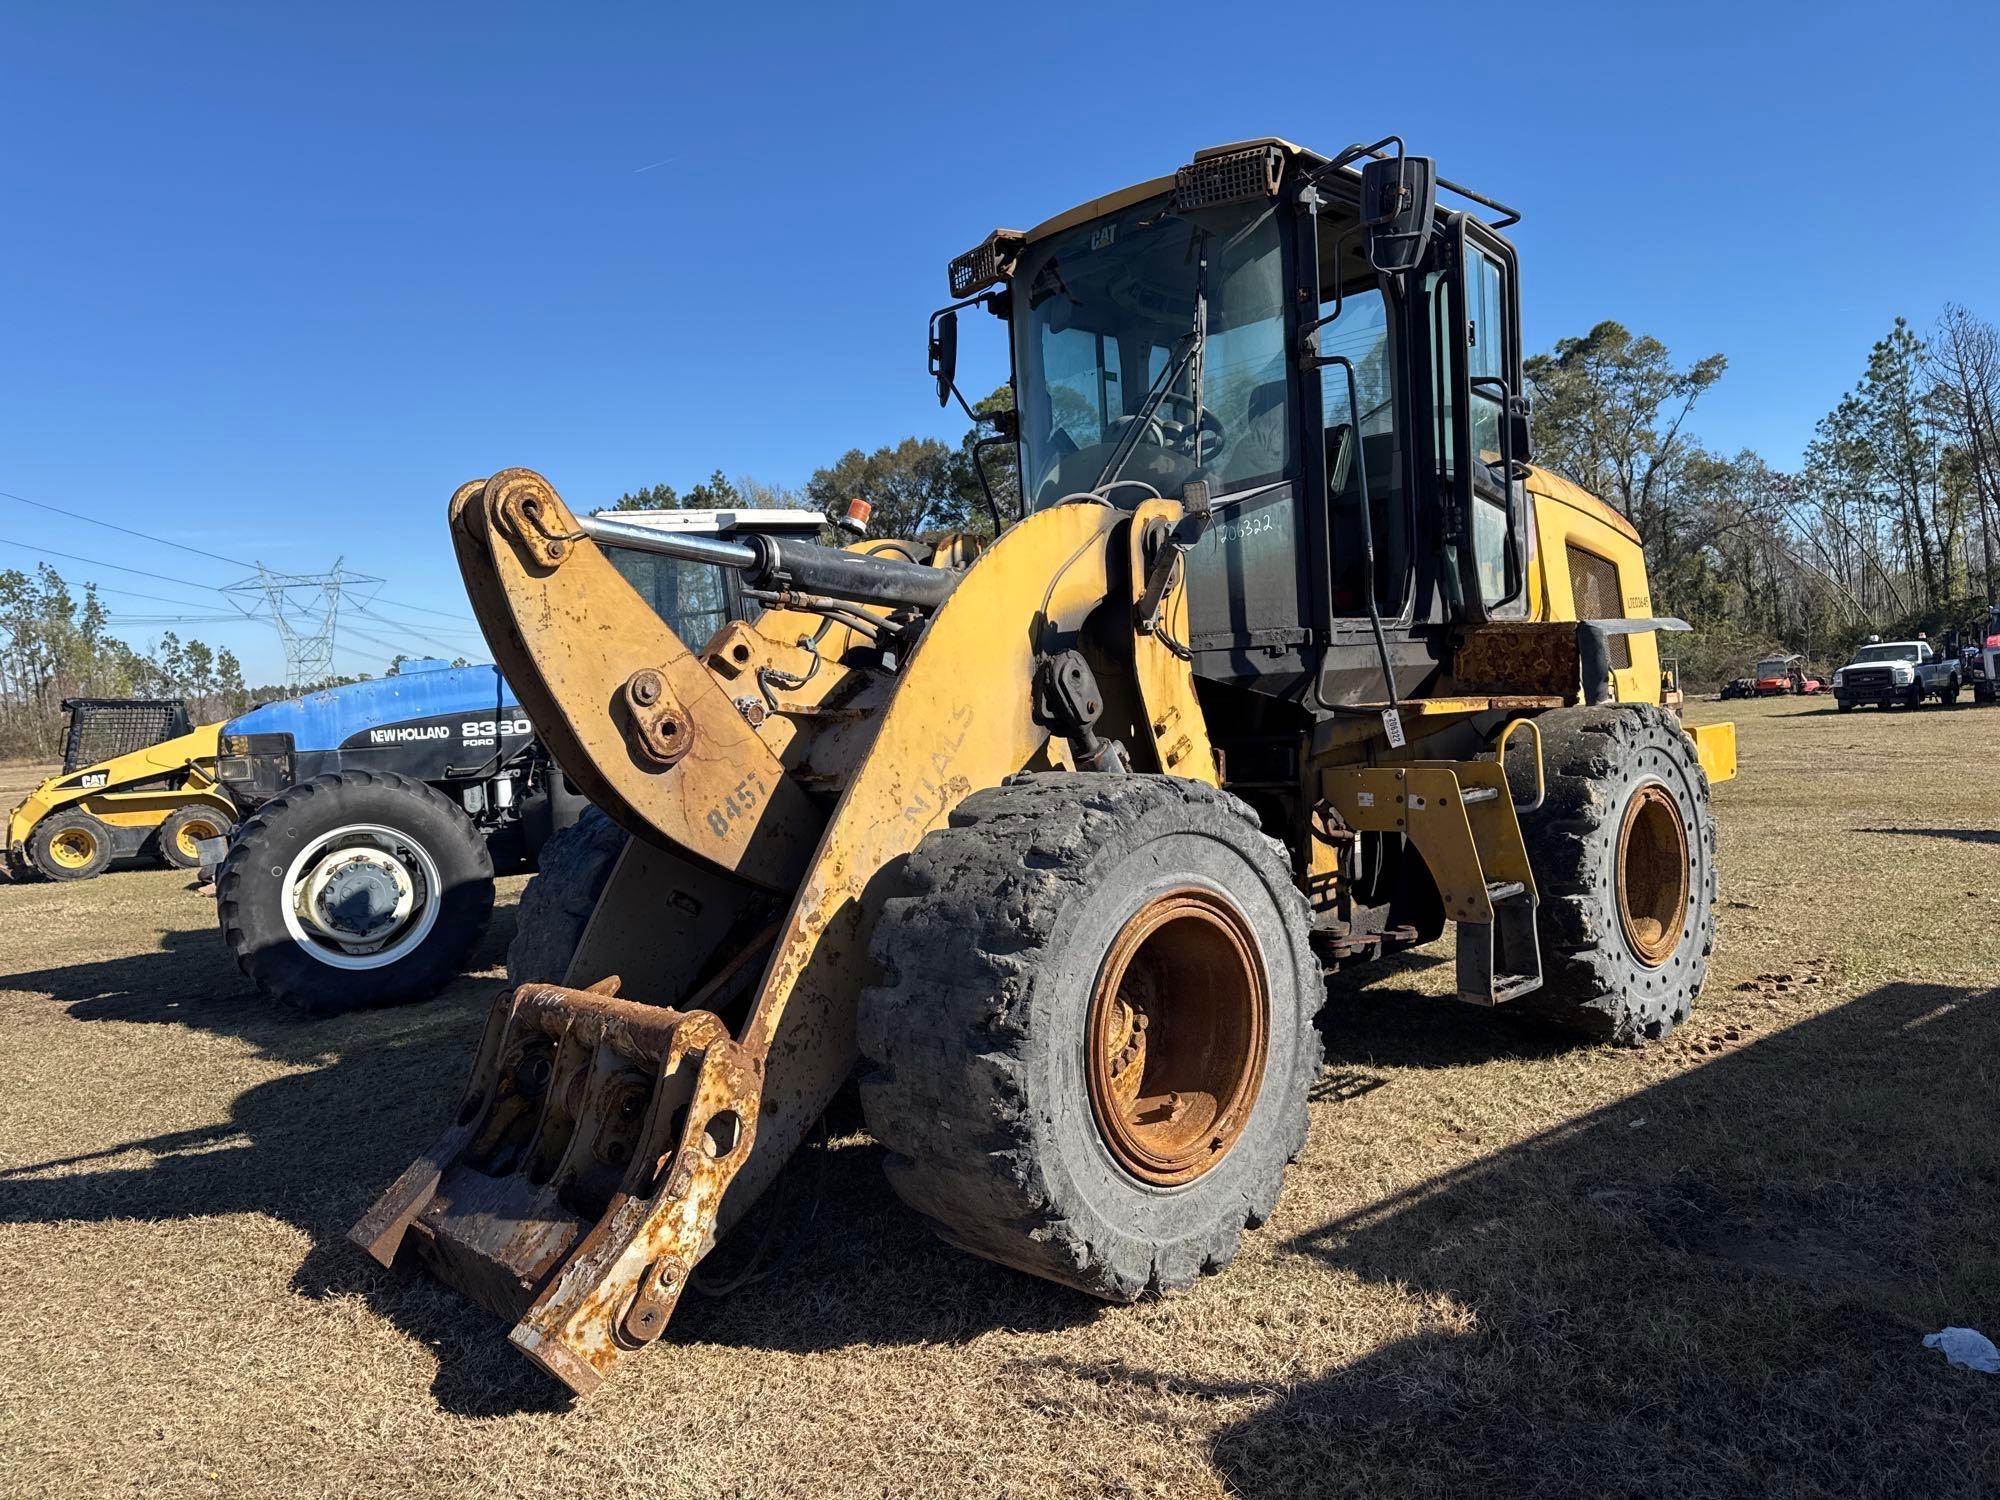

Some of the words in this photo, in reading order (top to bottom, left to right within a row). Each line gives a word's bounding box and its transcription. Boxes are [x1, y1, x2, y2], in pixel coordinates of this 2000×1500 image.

[1091, 223, 1117, 250] CAT
[1220, 514, 1273, 544] 206322
[370, 728, 395, 743] NEW
[397, 726, 450, 741] HOLLAND
[461, 719, 532, 737] 8360
[462, 738, 495, 747] FORD
[1389, 717, 1401, 743] 206322
[81, 773, 107, 788] CAT
